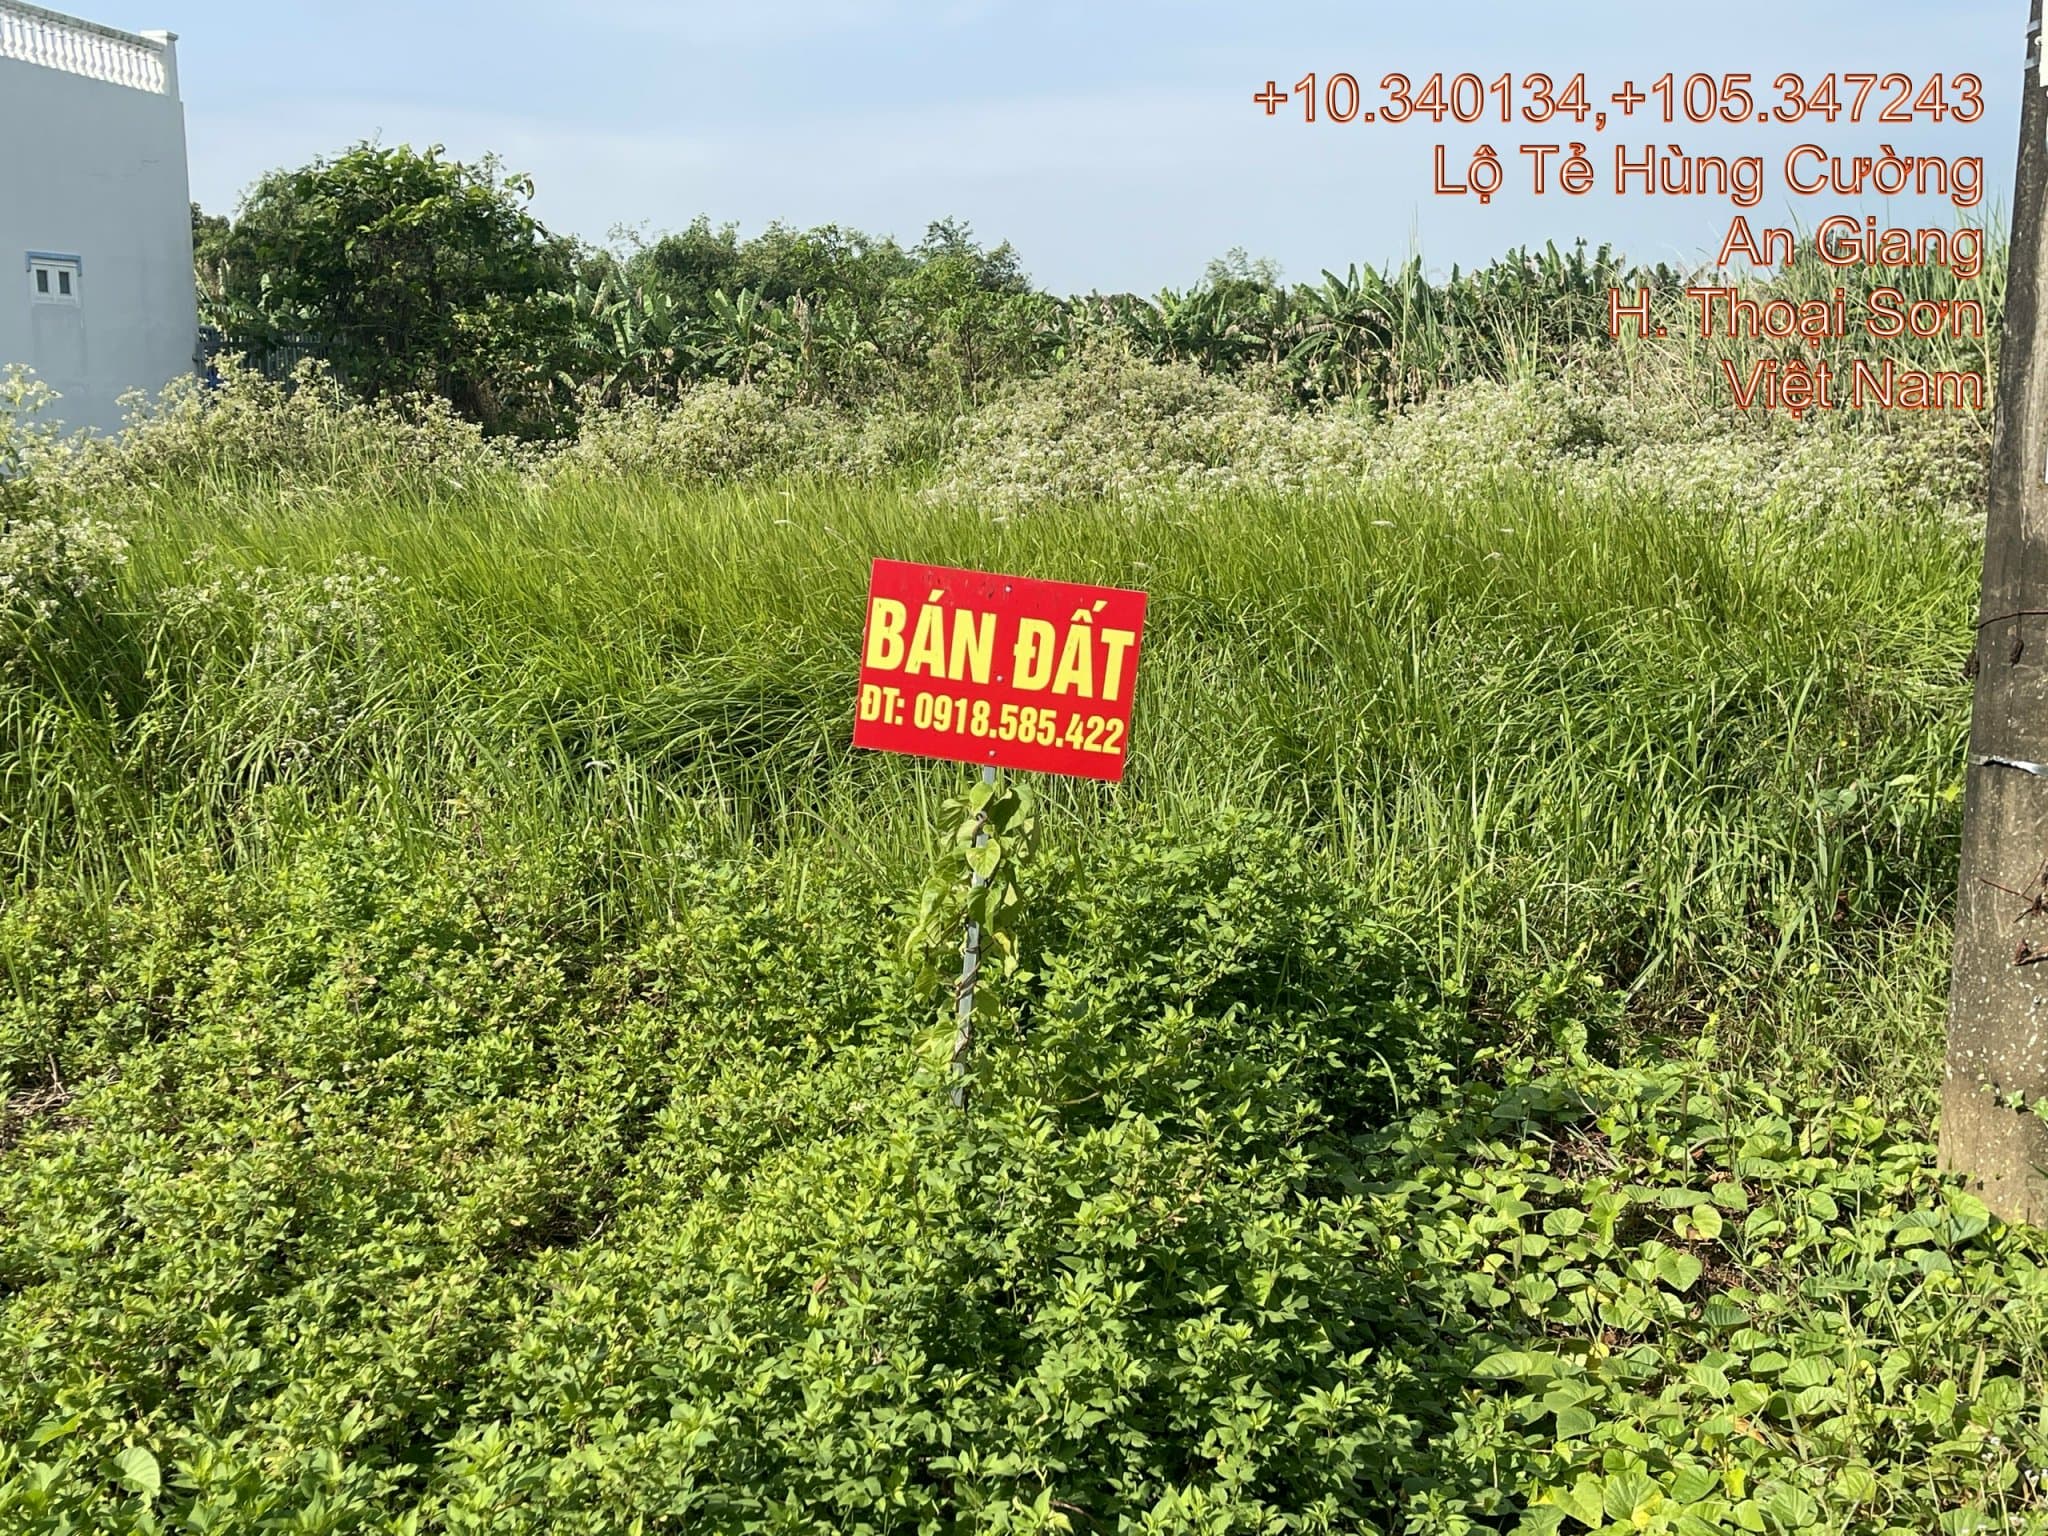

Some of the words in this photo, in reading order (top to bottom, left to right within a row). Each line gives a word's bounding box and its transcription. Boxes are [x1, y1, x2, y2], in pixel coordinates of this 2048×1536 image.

[865, 589, 997, 685] BÁN
[1012, 600, 1135, 702] ĐẤT
[860, 684, 905, 726] ĐT:
[914, 692, 1125, 755] 0918.585.422
